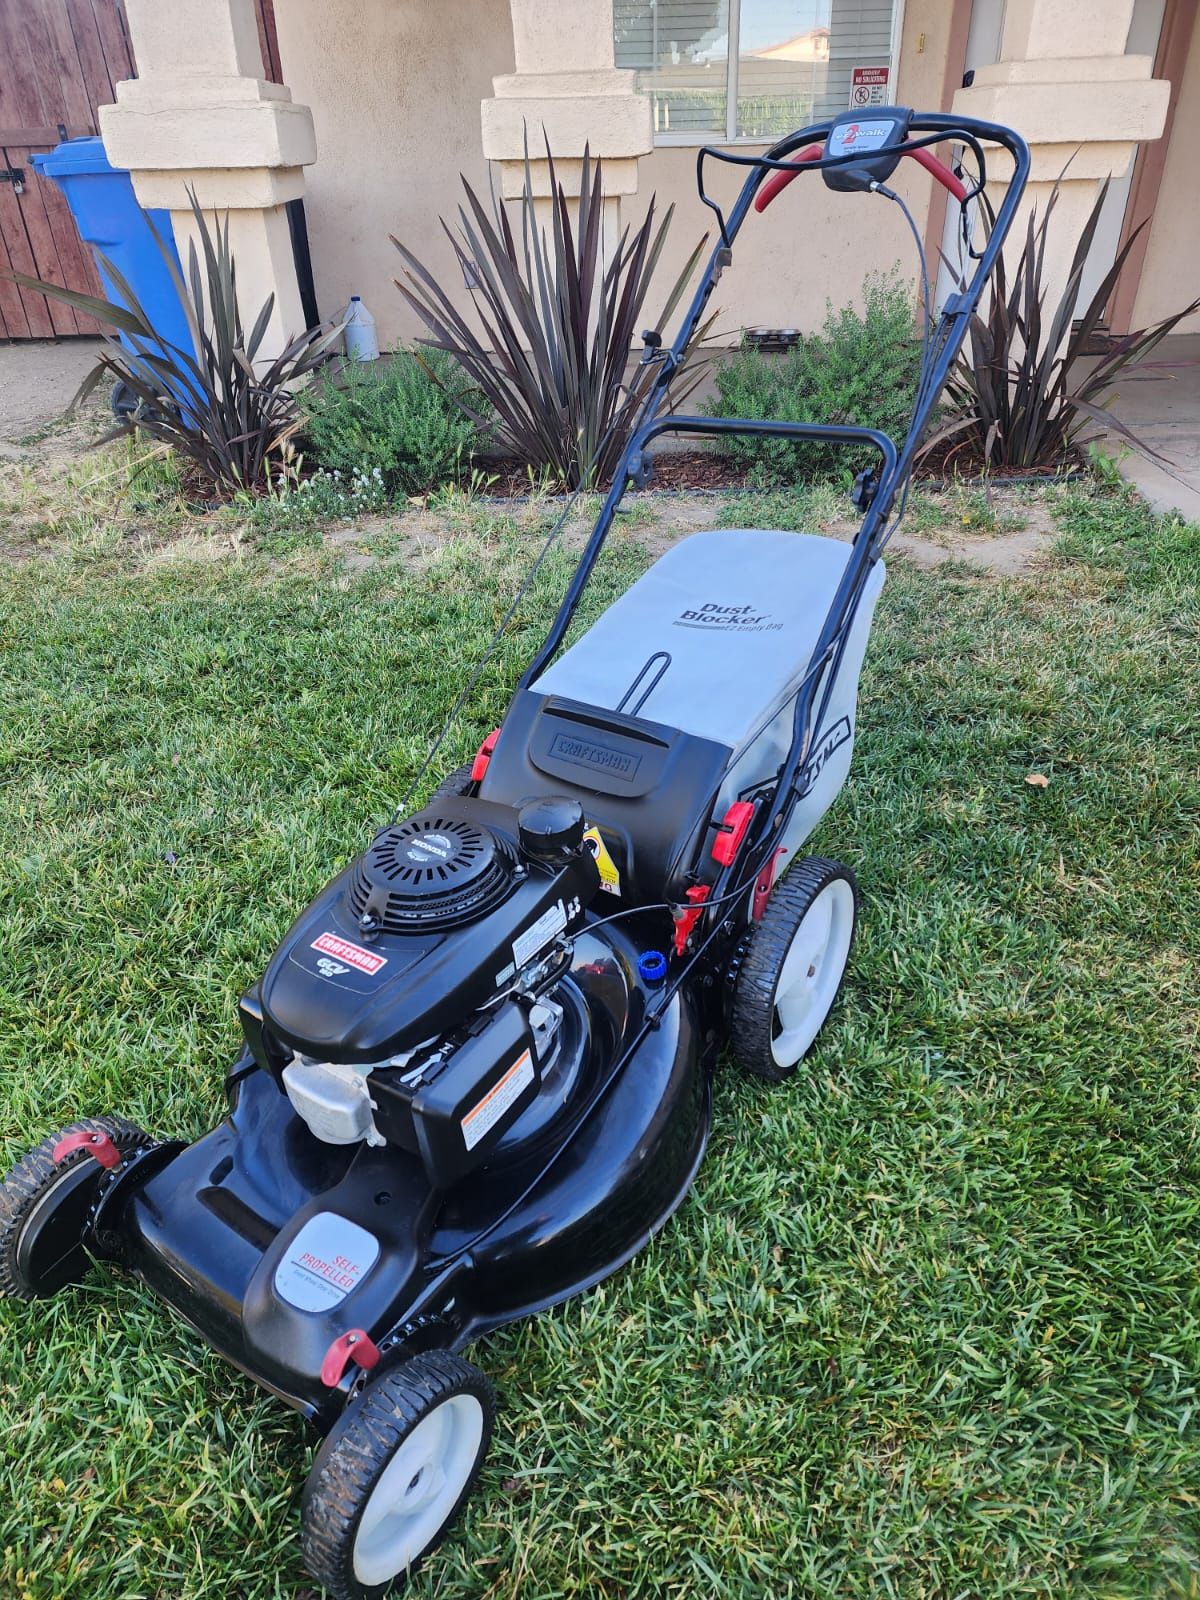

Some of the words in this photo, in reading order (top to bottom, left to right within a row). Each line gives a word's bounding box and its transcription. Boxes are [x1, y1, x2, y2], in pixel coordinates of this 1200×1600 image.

[680, 610, 768, 624] Blocker
[700, 603, 757, 615] Dust-
[557, 741, 632, 772] CRAFTSMAN
[411, 839, 447, 858] HONDA
[318, 937, 378, 969] CRAFTSMAN
[317, 958, 350, 974] GCV
[299, 1252, 354, 1288] PROPELLED
